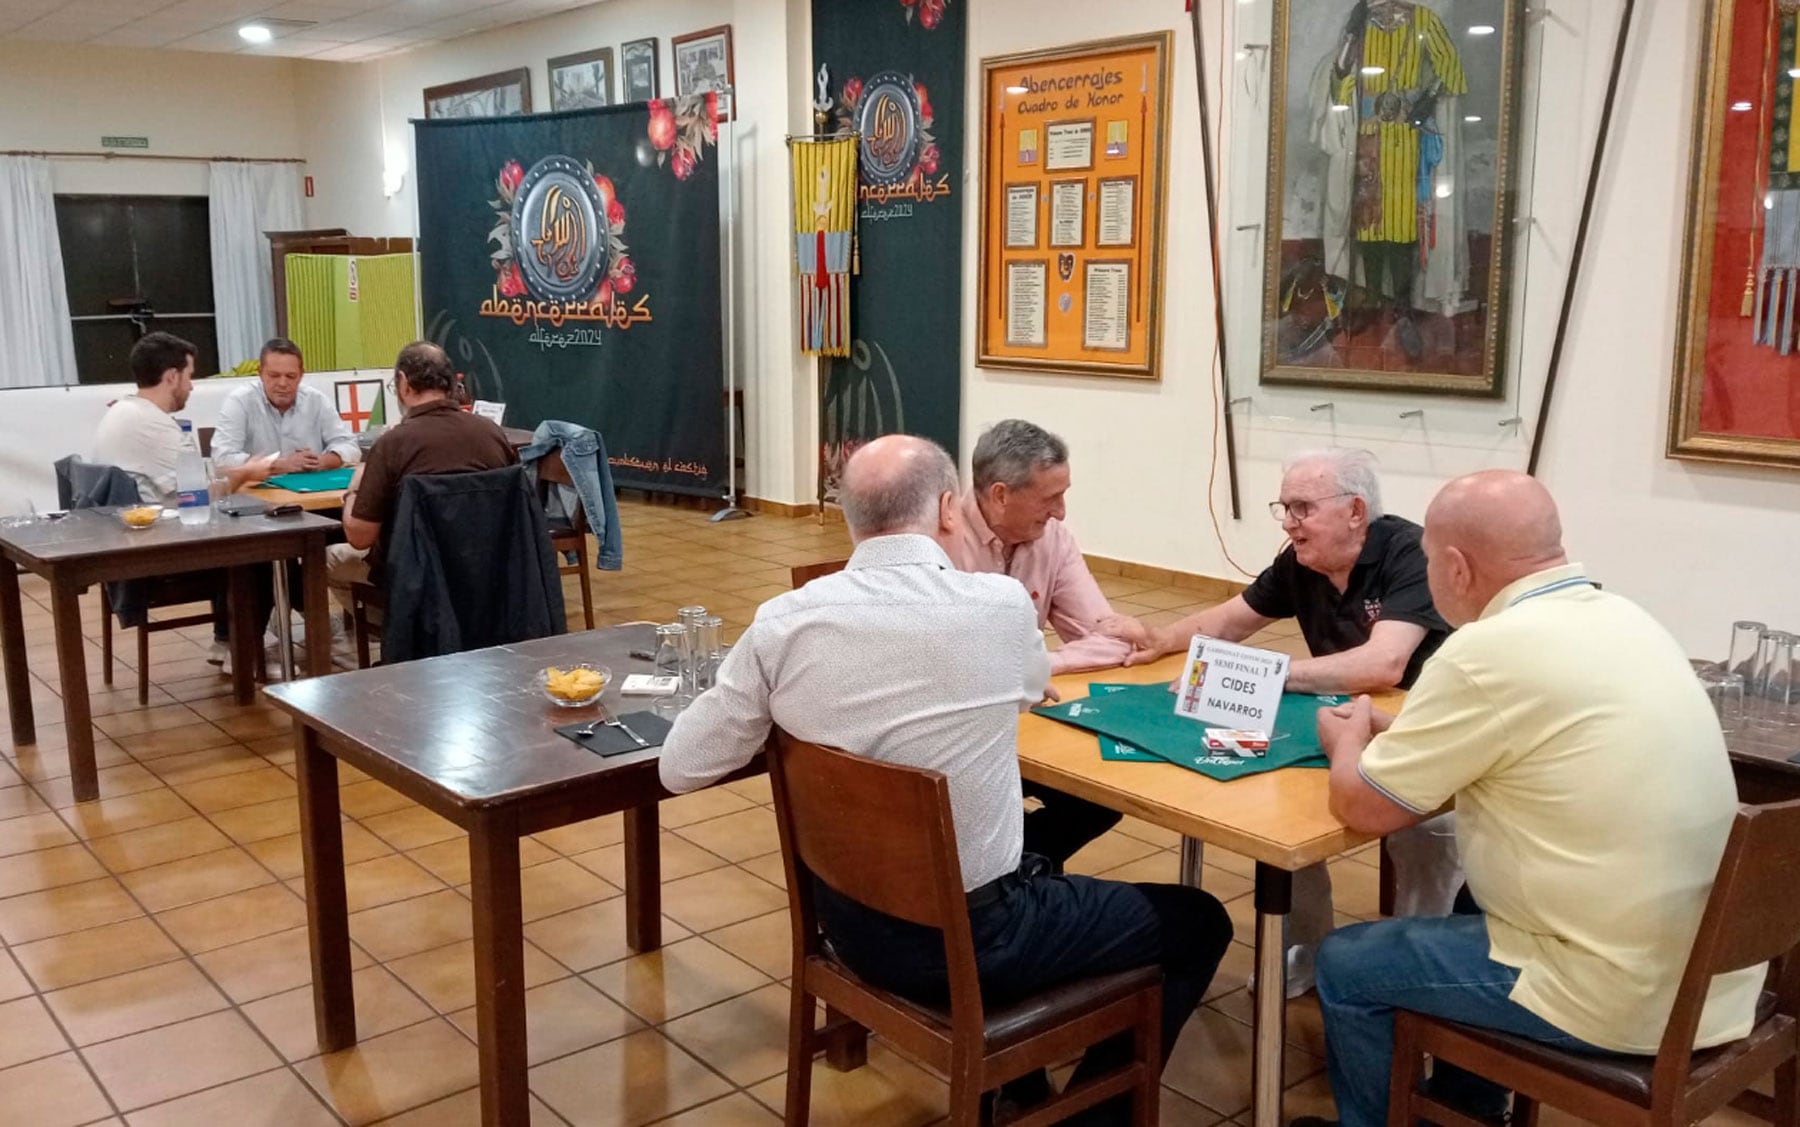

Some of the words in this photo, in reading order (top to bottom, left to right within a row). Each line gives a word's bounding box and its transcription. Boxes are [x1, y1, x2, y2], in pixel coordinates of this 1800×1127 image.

[1019, 67, 1123, 94] Abencerrajes
[1018, 99, 1058, 114] Cuadro
[1065, 95, 1079, 110] de
[1087, 91, 1124, 108] Honor
[1214, 659, 1235, 670] SEMI
[1235, 662, 1259, 676] FINAL
[1221, 676, 1257, 695] CIDES
[1207, 697, 1264, 719] NAVARROS
